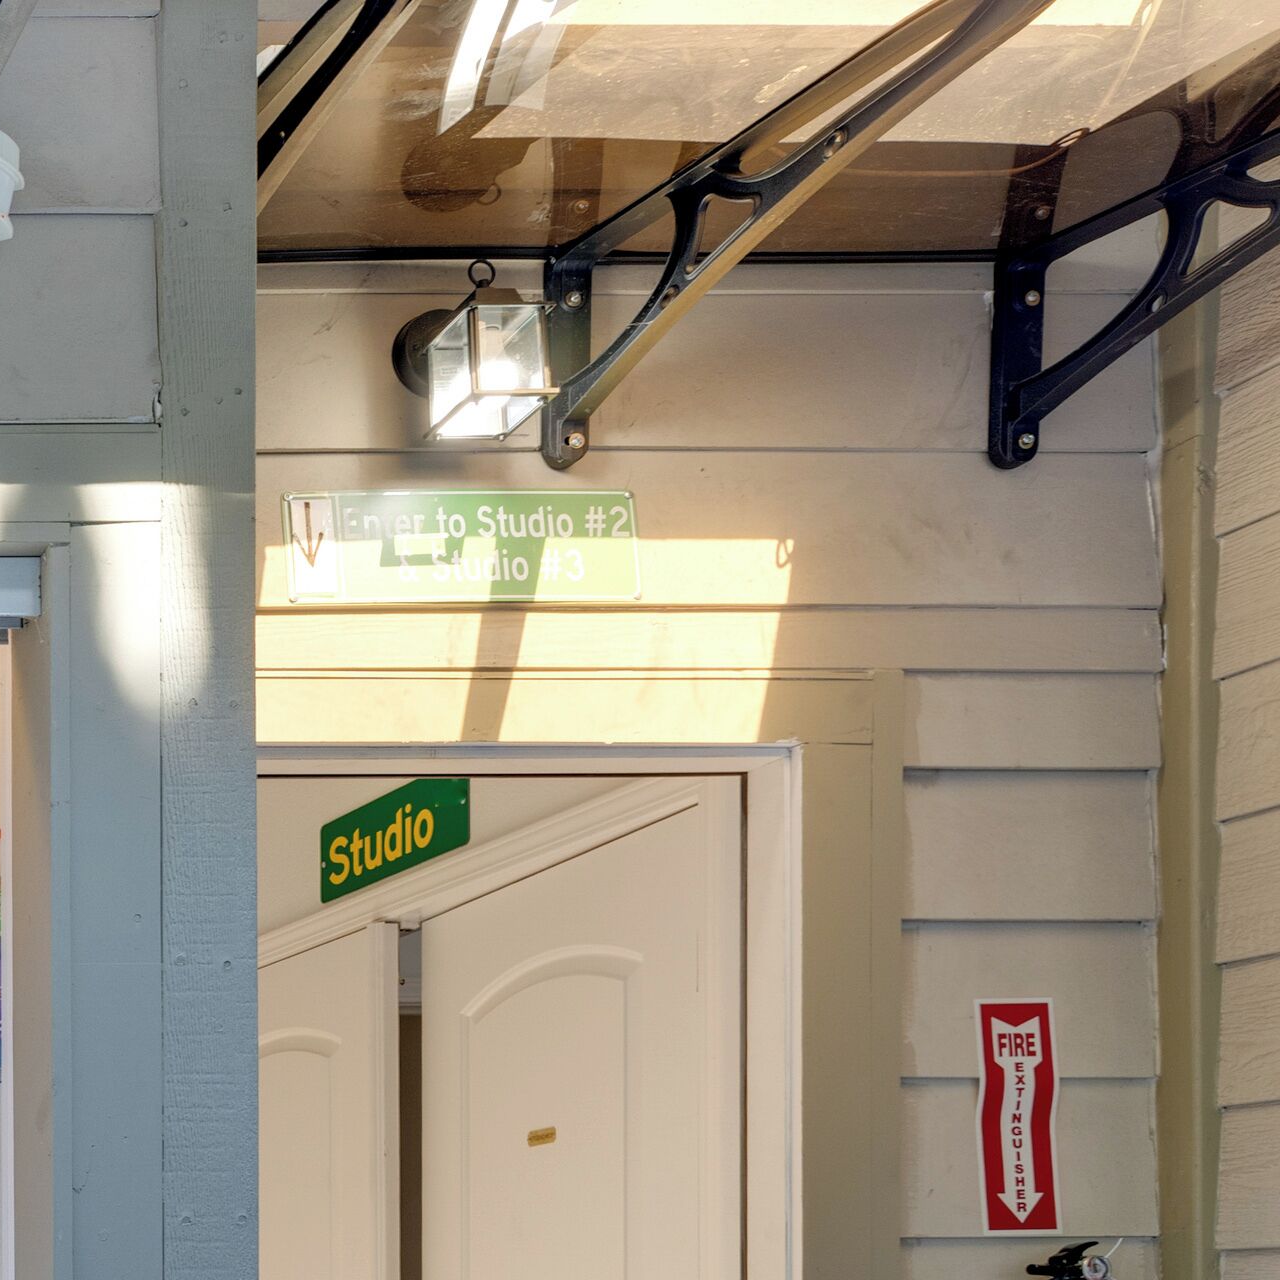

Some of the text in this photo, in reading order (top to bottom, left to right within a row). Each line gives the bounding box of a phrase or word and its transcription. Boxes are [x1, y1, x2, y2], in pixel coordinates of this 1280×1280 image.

[435, 506, 467, 538] to
[476, 504, 574, 539] Studio
[584, 505, 631, 539] #2
[431, 547, 530, 582] Studio
[540, 549, 586, 582] #3
[329, 803, 435, 885] Studio
[997, 1033, 1037, 1057] FIRE
[1011, 1061, 1028, 1213] EXTINGUISHER
